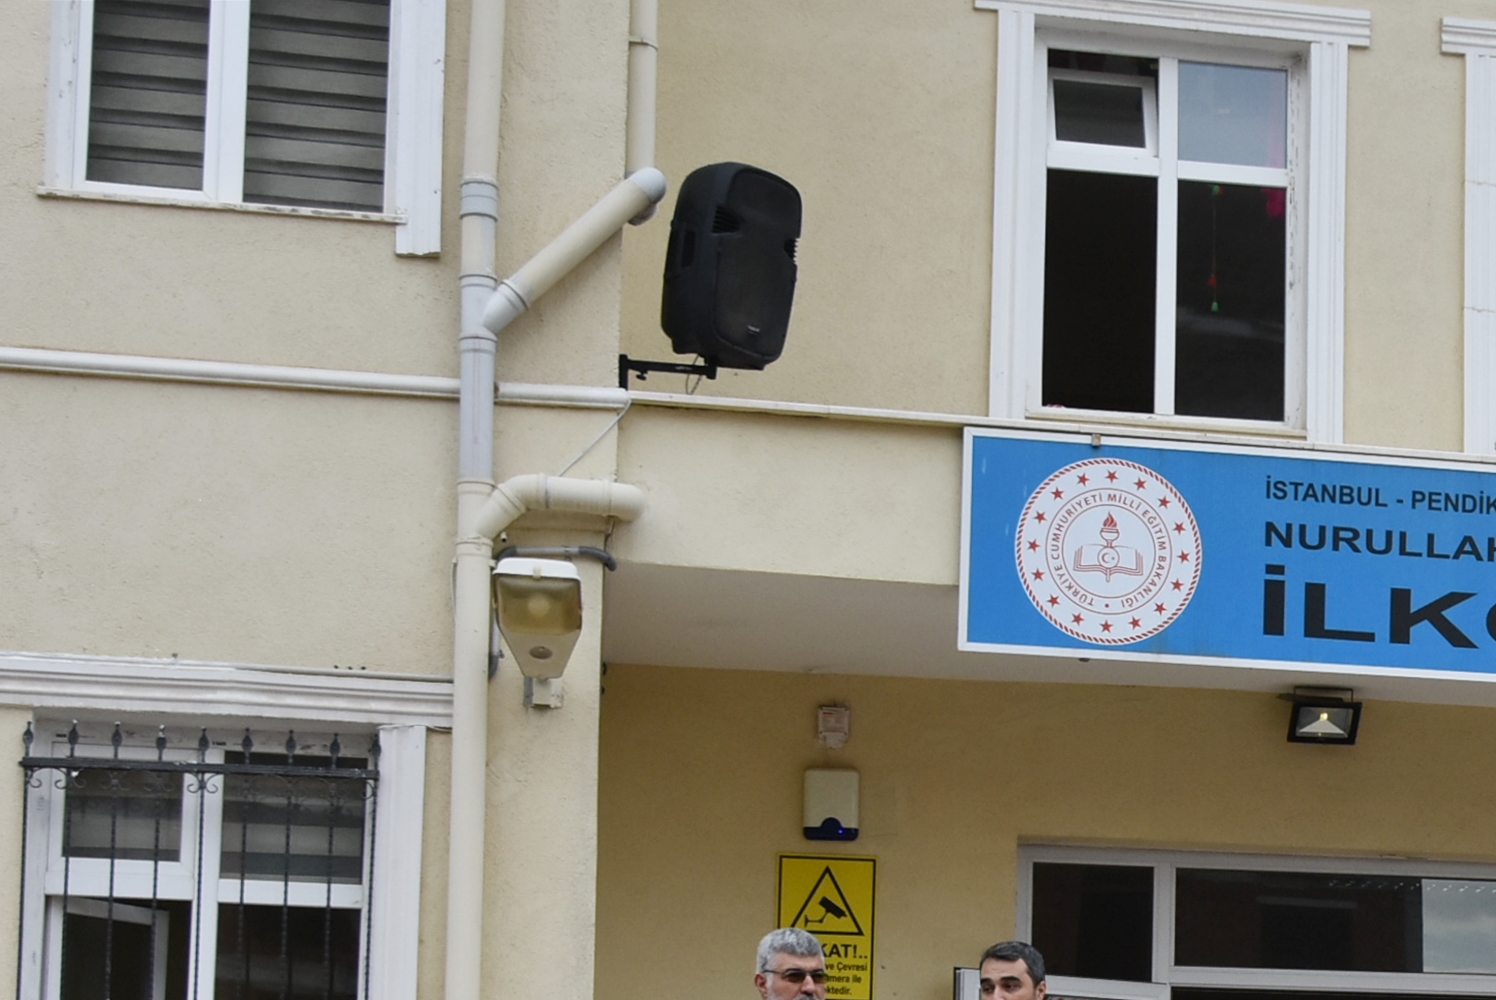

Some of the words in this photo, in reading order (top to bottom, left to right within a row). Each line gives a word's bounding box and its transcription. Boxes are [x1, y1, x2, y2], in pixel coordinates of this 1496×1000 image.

[1107, 492, 1143, 511] MİLLİ
[1265, 474, 1388, 508] İSTANBUL
[1051, 492, 1103, 561] CUMHURİYETİ
[1141, 509, 1167, 551] EĞİTİM
[1053, 563, 1095, 607] TÜRKİYE
[1121, 555, 1167, 609] BAKANLIĞI
[836, 961, 868, 974] Çevresi
